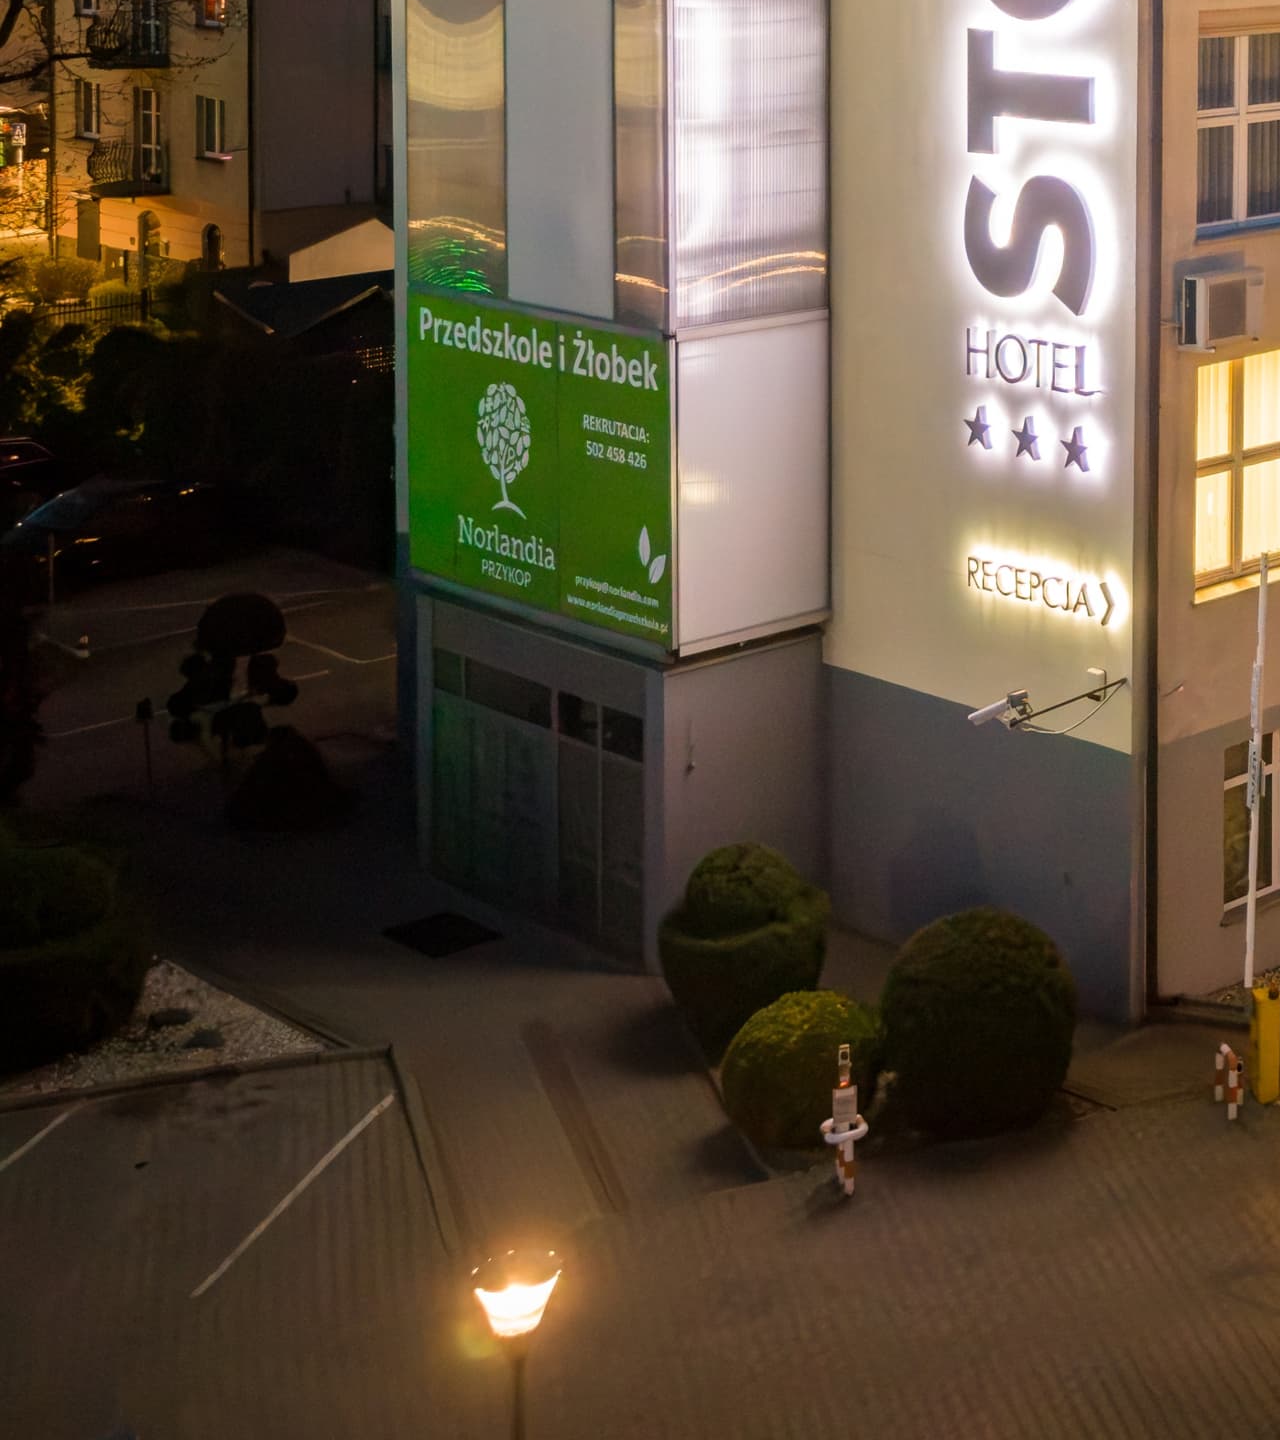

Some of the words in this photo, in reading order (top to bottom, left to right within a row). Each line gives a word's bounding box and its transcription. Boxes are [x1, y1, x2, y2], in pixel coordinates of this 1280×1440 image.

[418, 306, 553, 369] Przedszkole
[558, 334, 566, 372] i
[571, 329, 660, 392] Żłobek
[965, 326, 1103, 397] HOTEL
[585, 440, 605, 459] 502
[606, 446, 626, 464] 458
[627, 451, 648, 470] 426
[457, 513, 557, 571] Norlandia
[480, 558, 532, 588] PRZYKOP
[966, 556, 1097, 618] RECEPCJA
